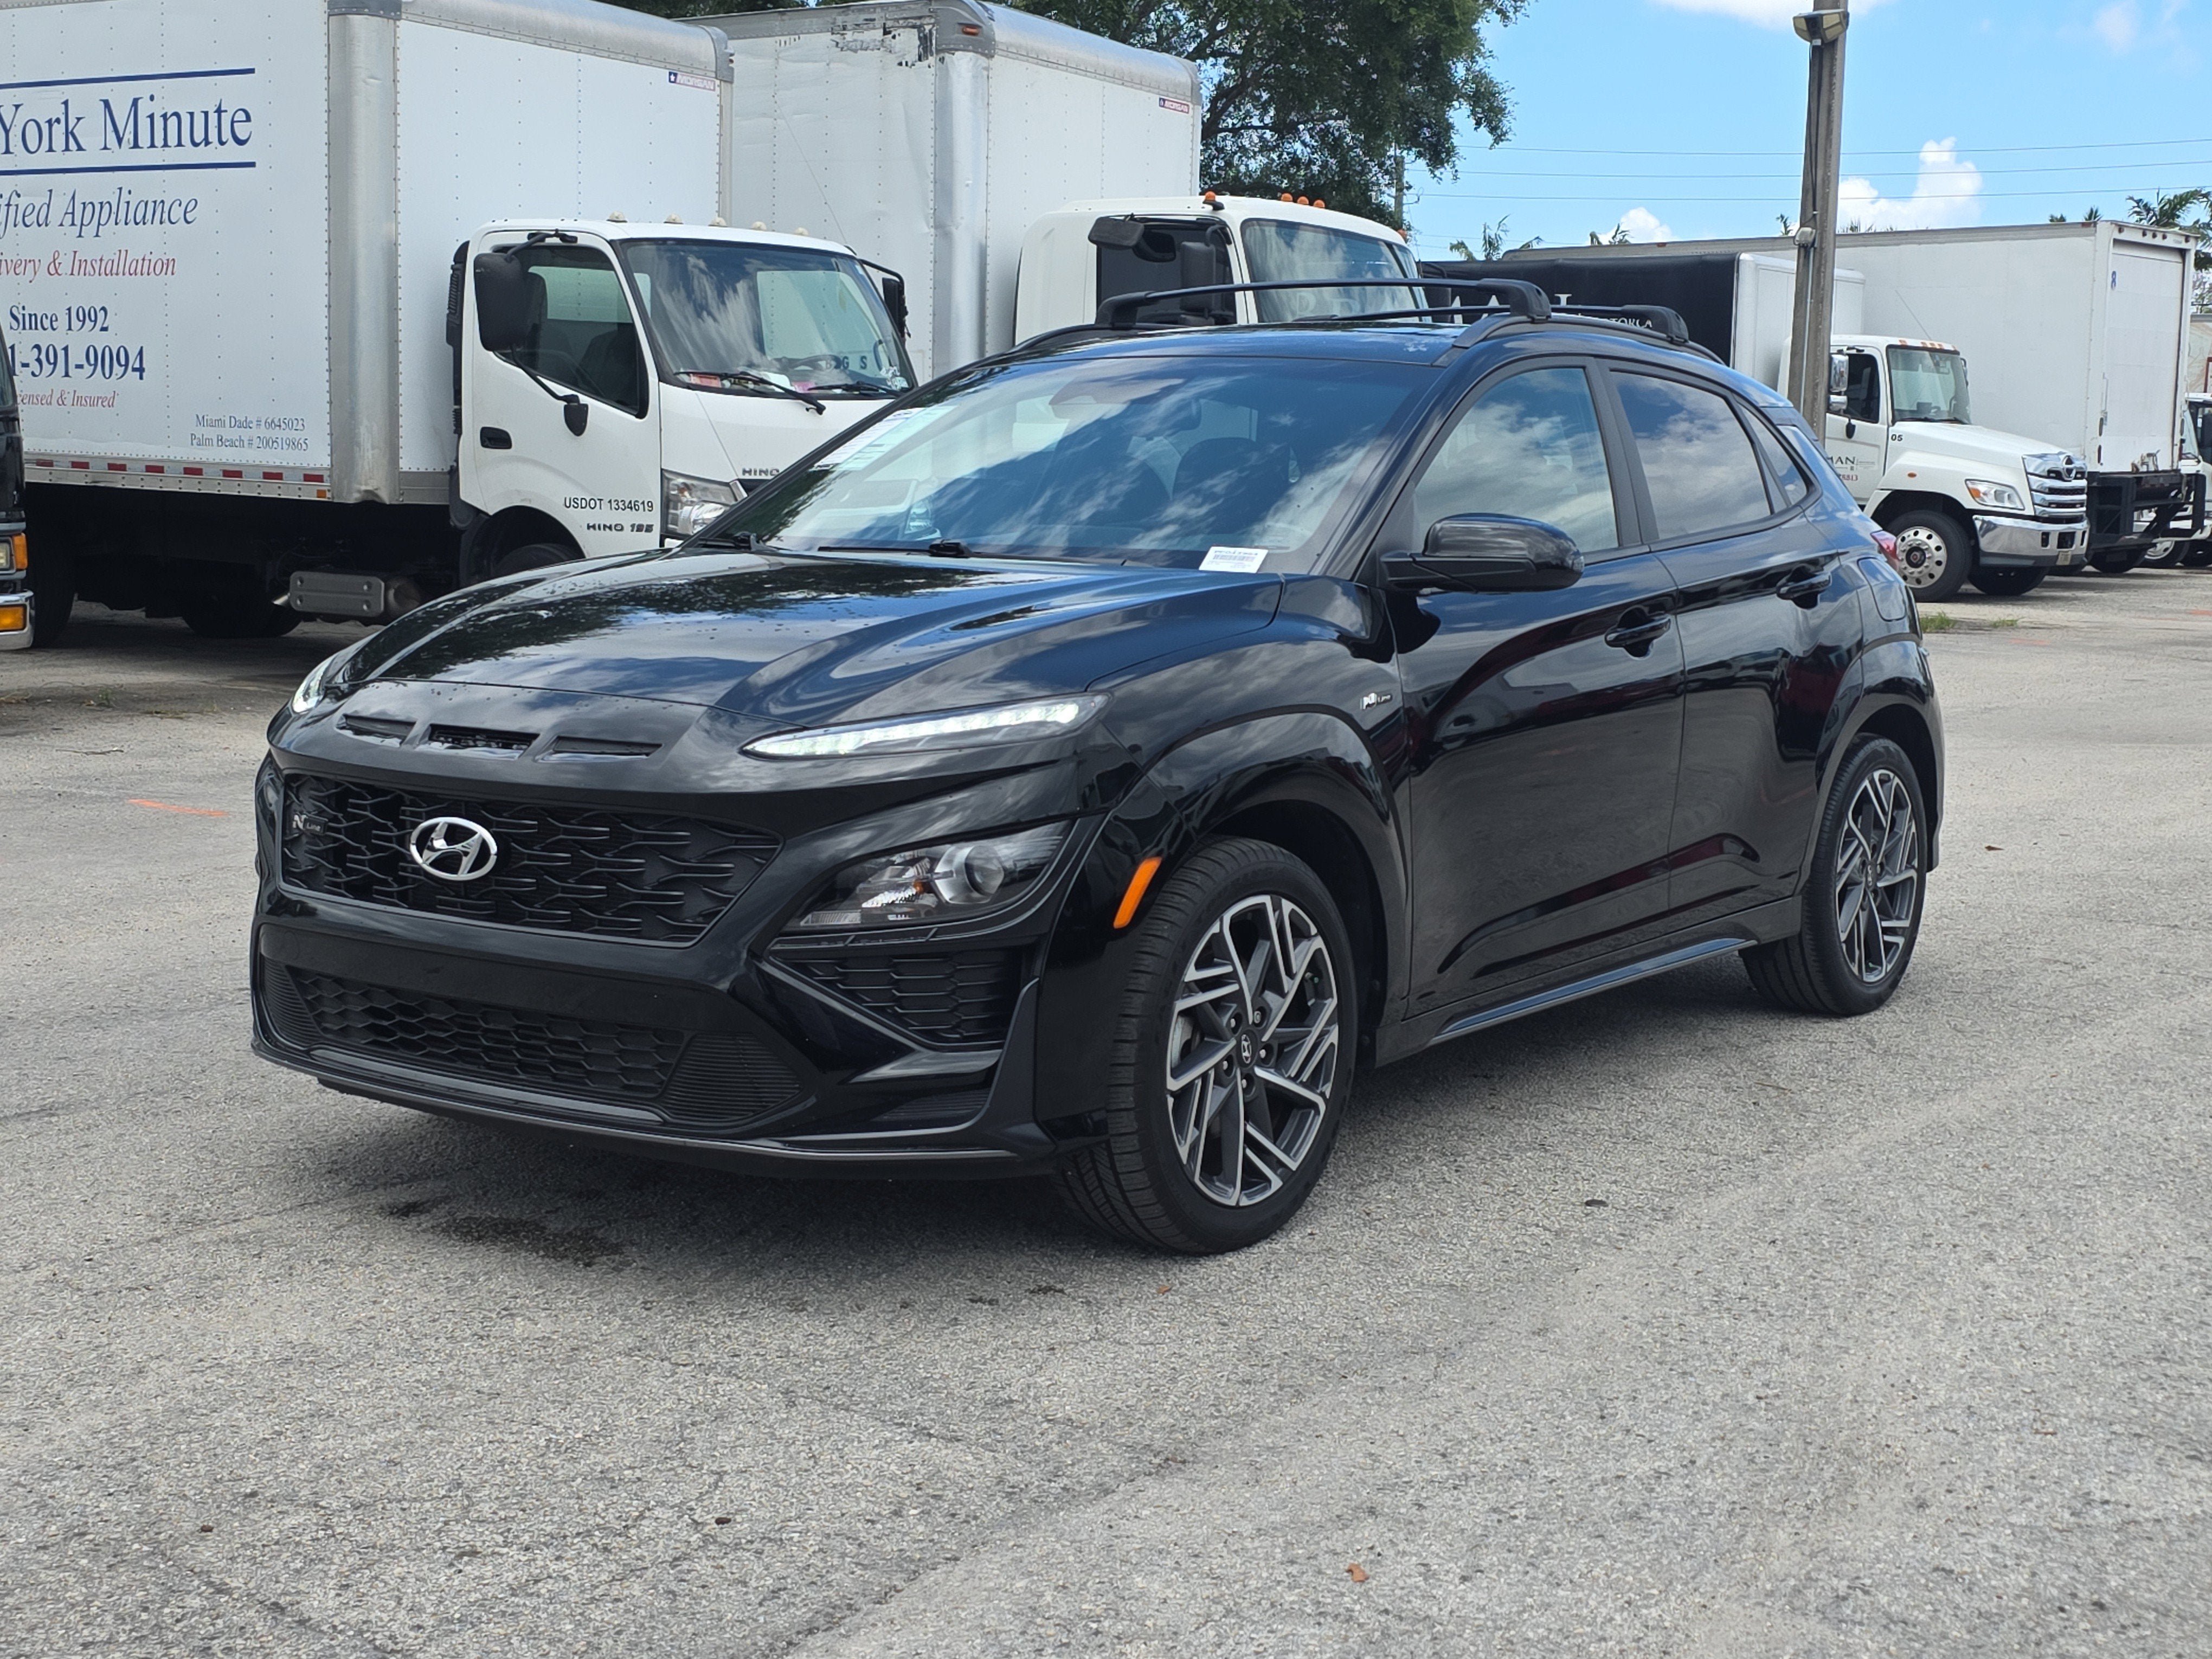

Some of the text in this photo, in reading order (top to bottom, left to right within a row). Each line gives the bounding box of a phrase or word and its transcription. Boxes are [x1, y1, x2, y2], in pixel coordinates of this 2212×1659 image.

[0, 94, 253, 155] York Minute
[57, 187, 198, 238] Appliance
[47, 250, 62, 276] &
[69, 249, 176, 276] Installation
[9, 305, 109, 332] Since 1992
[56, 389, 67, 406] &
[71, 389, 115, 408] Insured
[196, 414, 305, 431] Miami Dade # 6645023
[190, 433, 308, 451] Palm Beach # 200519865
[564, 497, 653, 512] USDOT 1334619
[587, 523, 624, 532] HINO
